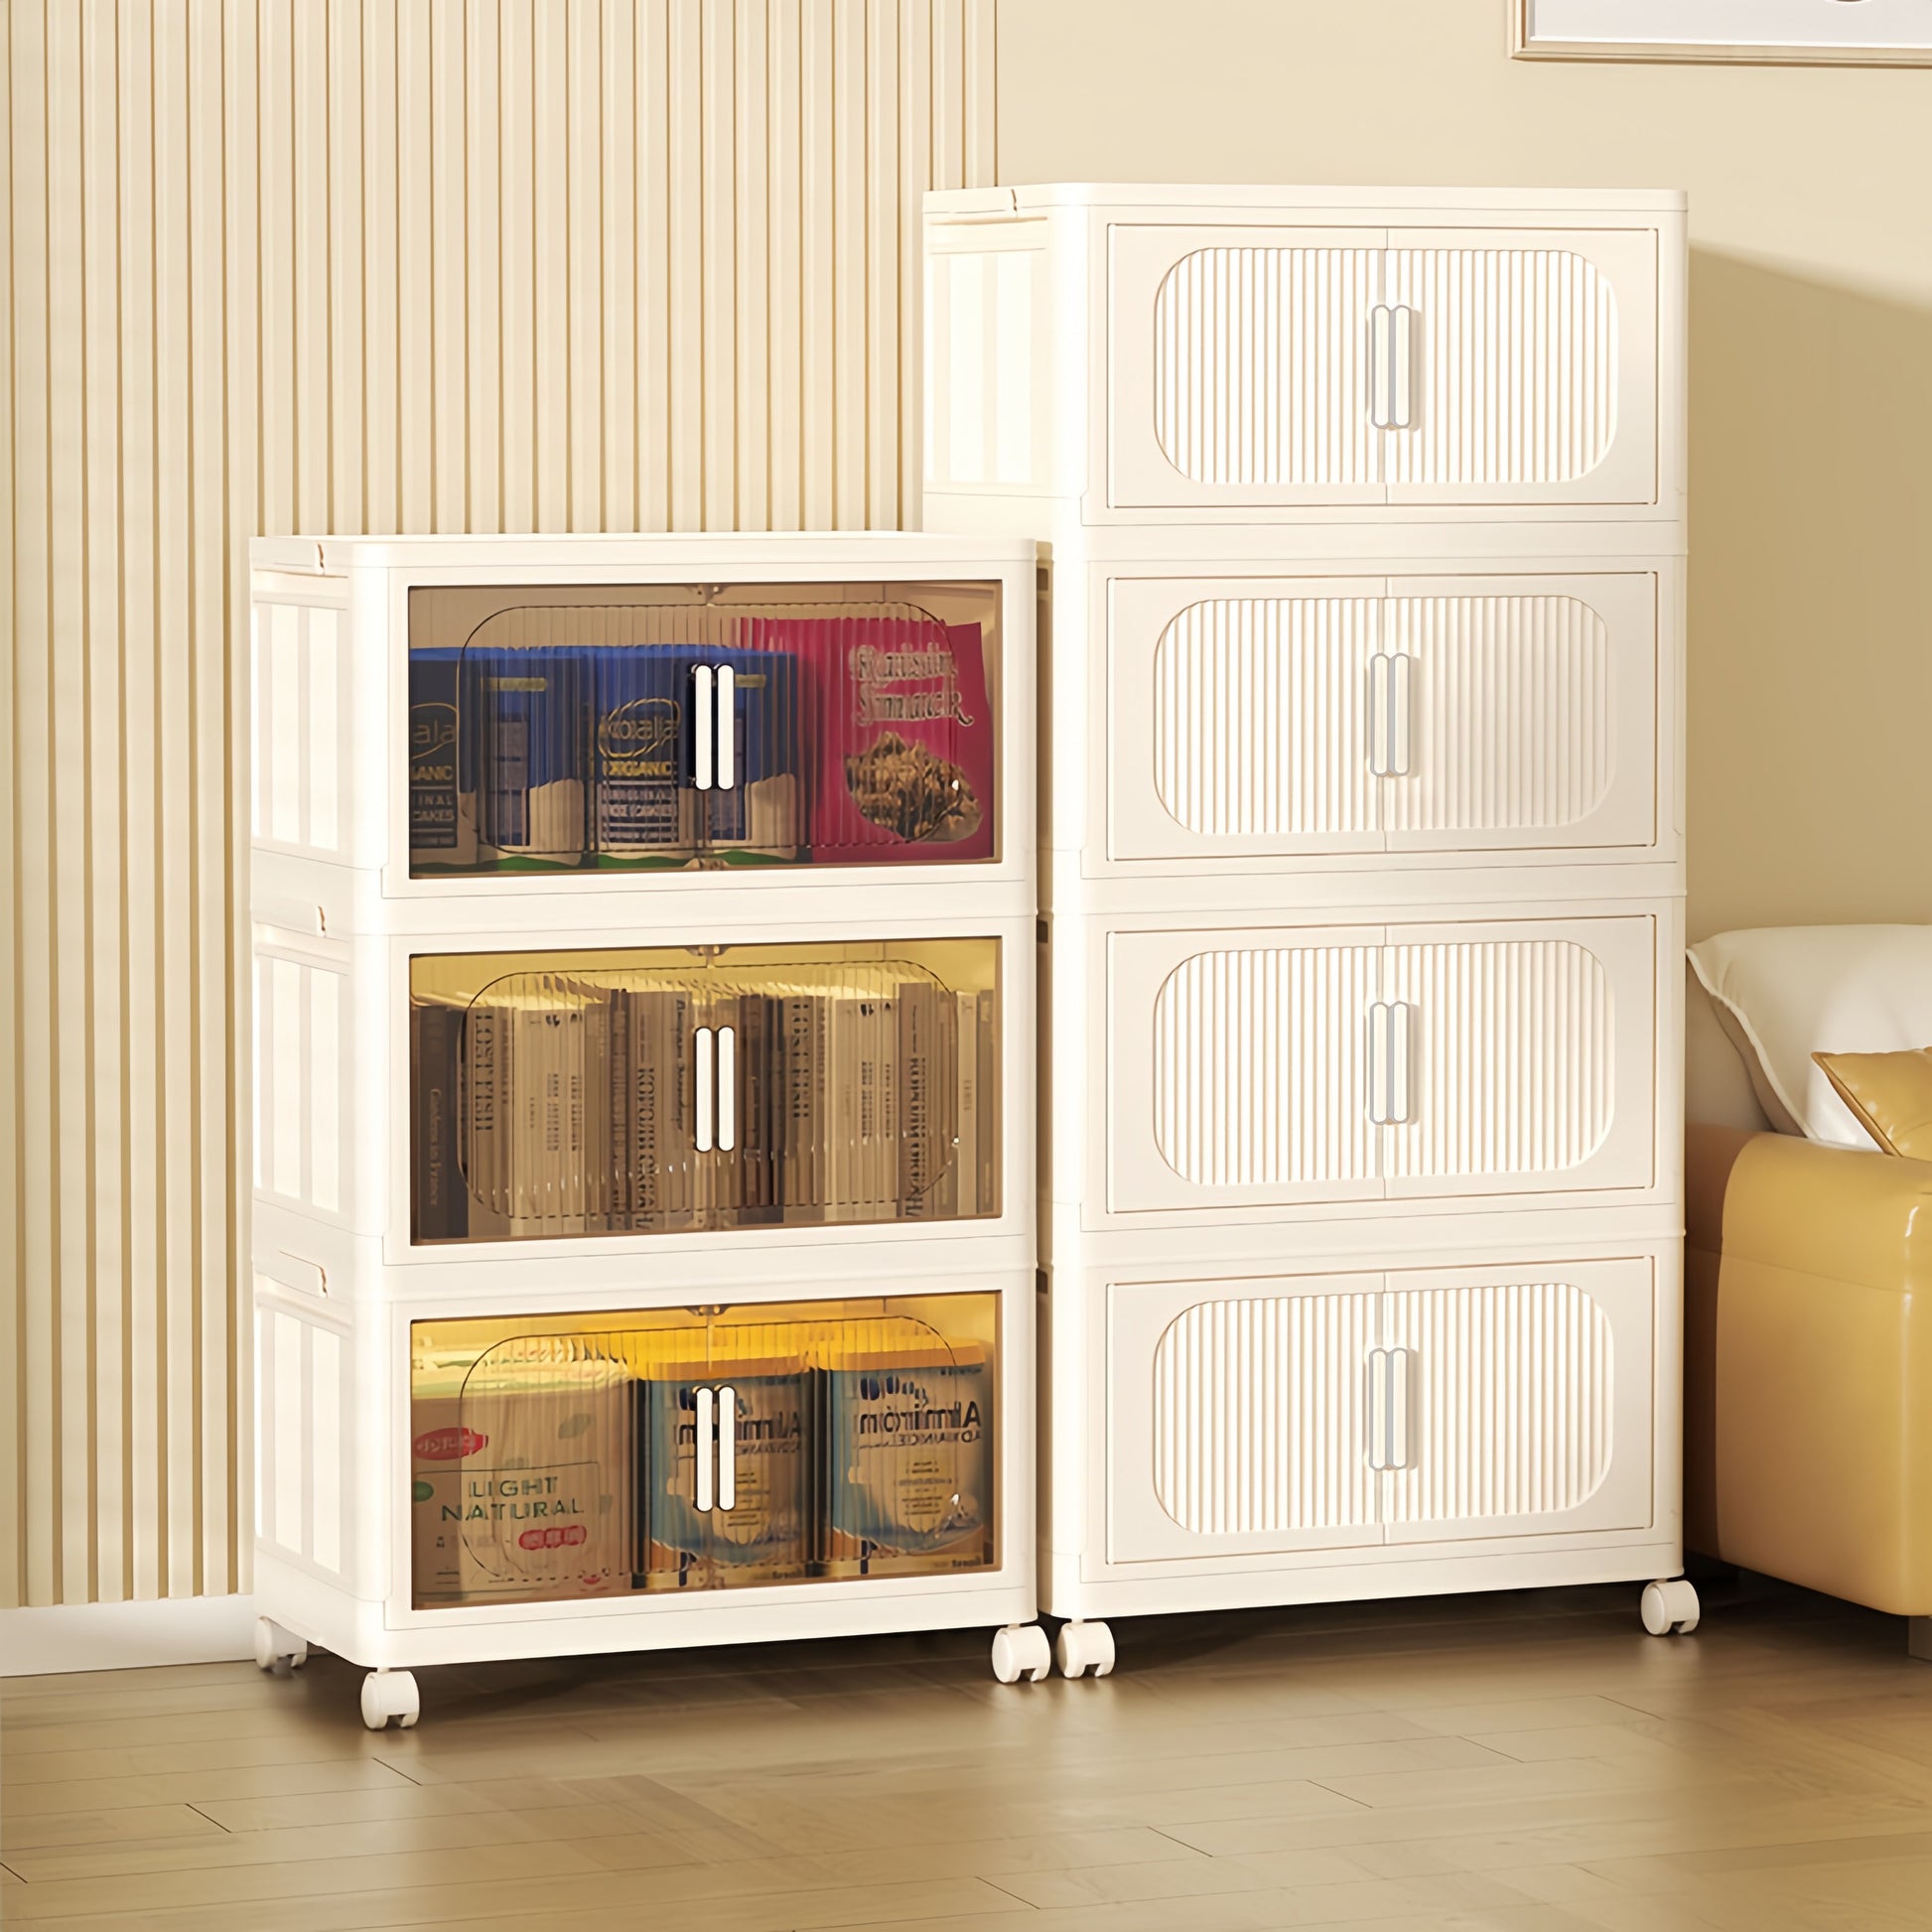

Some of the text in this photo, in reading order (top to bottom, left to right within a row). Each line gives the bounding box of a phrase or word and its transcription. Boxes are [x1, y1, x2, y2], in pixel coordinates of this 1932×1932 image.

[413, 719, 457, 744] ala
[412, 765, 454, 781] ANIC
[470, 1476, 559, 1498] LIGHT
[441, 1497, 585, 1522] NATURAL
